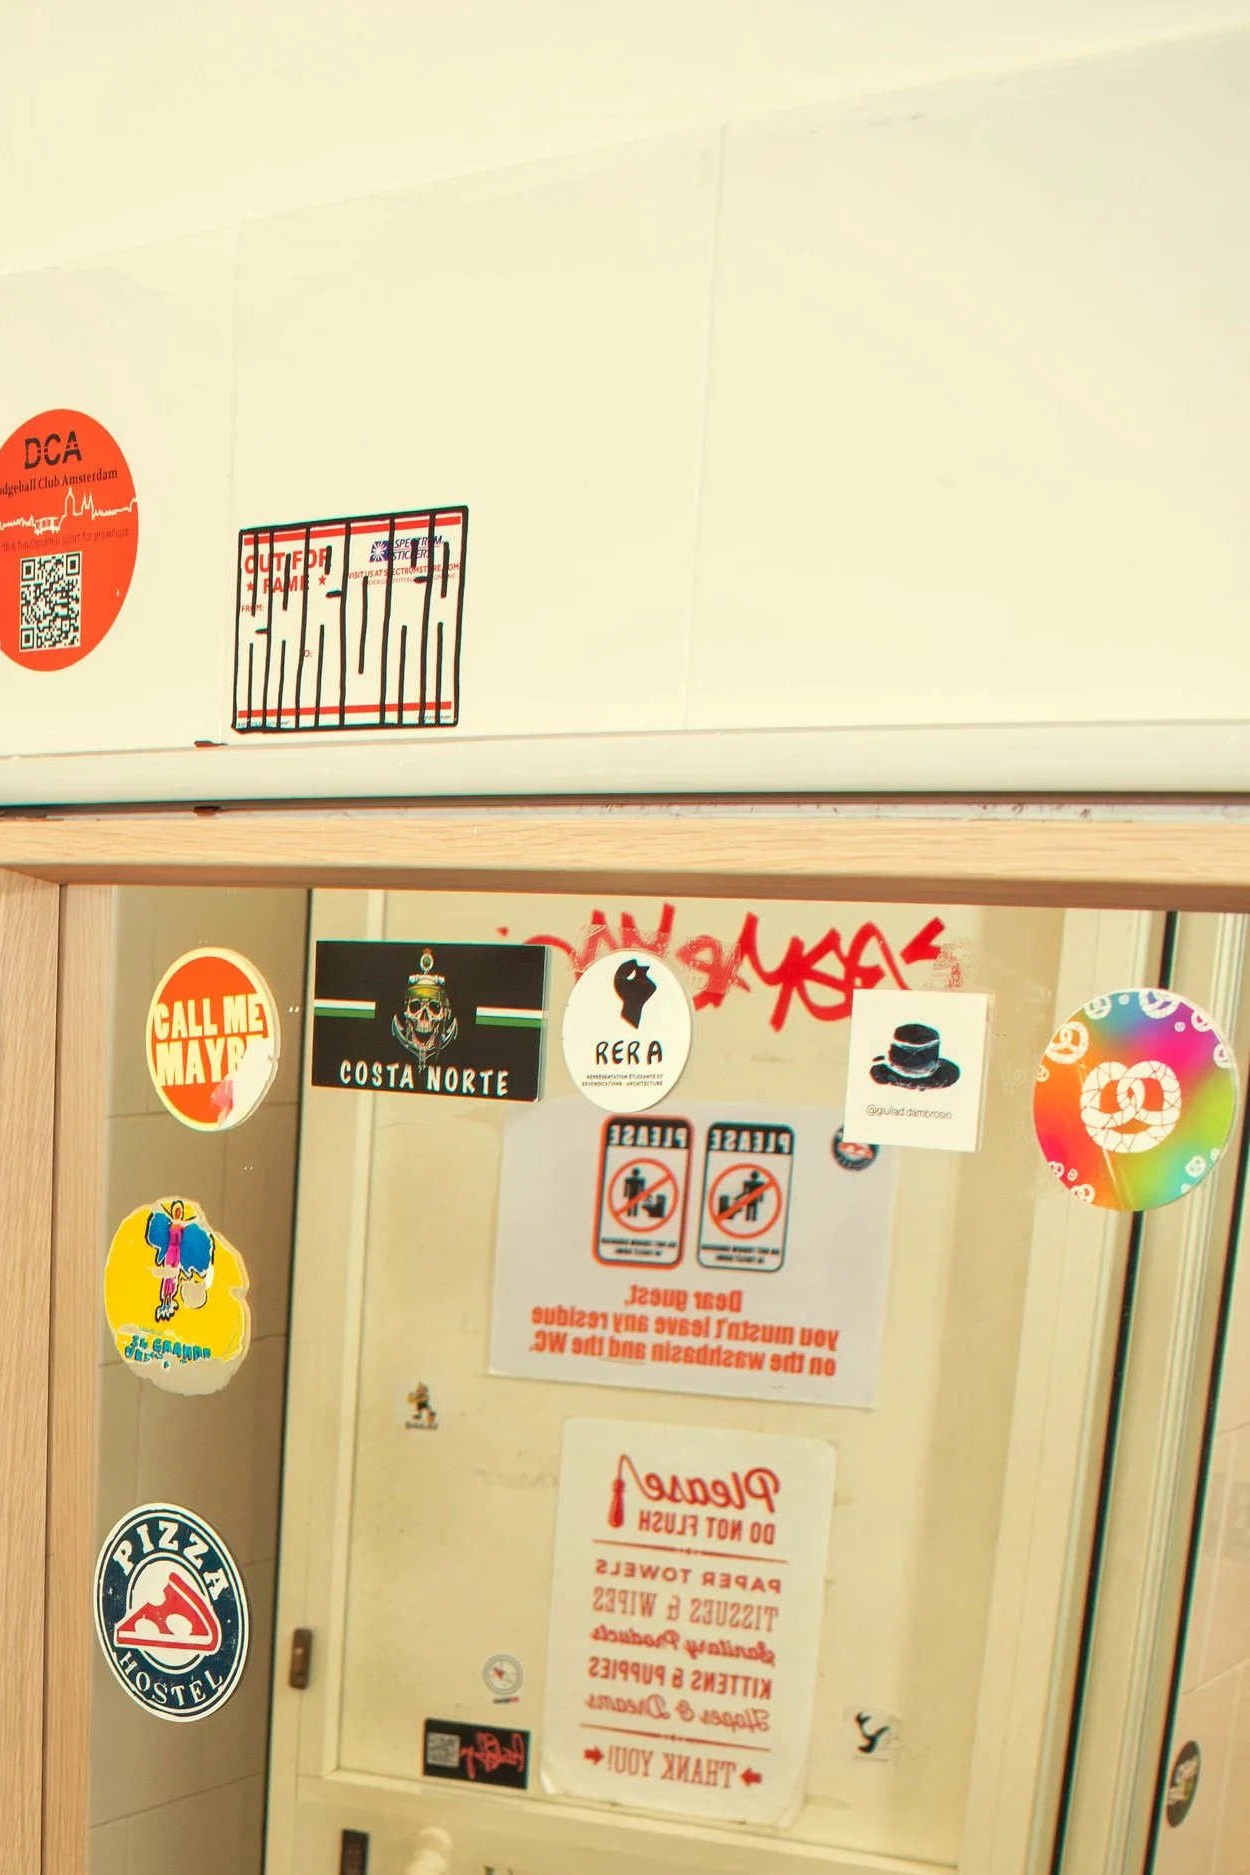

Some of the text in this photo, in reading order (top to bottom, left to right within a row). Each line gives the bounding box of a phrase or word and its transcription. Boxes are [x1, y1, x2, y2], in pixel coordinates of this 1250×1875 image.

[25, 430, 82, 470] DCA
[38, 477, 60, 489] Club
[62, 468, 118, 486] Amsterdam
[348, 571, 364, 579] VISIT
[153, 993, 264, 1040] CALL ME
[155, 1034, 265, 1087] MAYB
[595, 1040, 663, 1066] RERA
[339, 1059, 509, 1097] COSTA NORTE
[113, 1520, 230, 1601] PIZZA
[118, 1650, 224, 1706] HOSTEL
